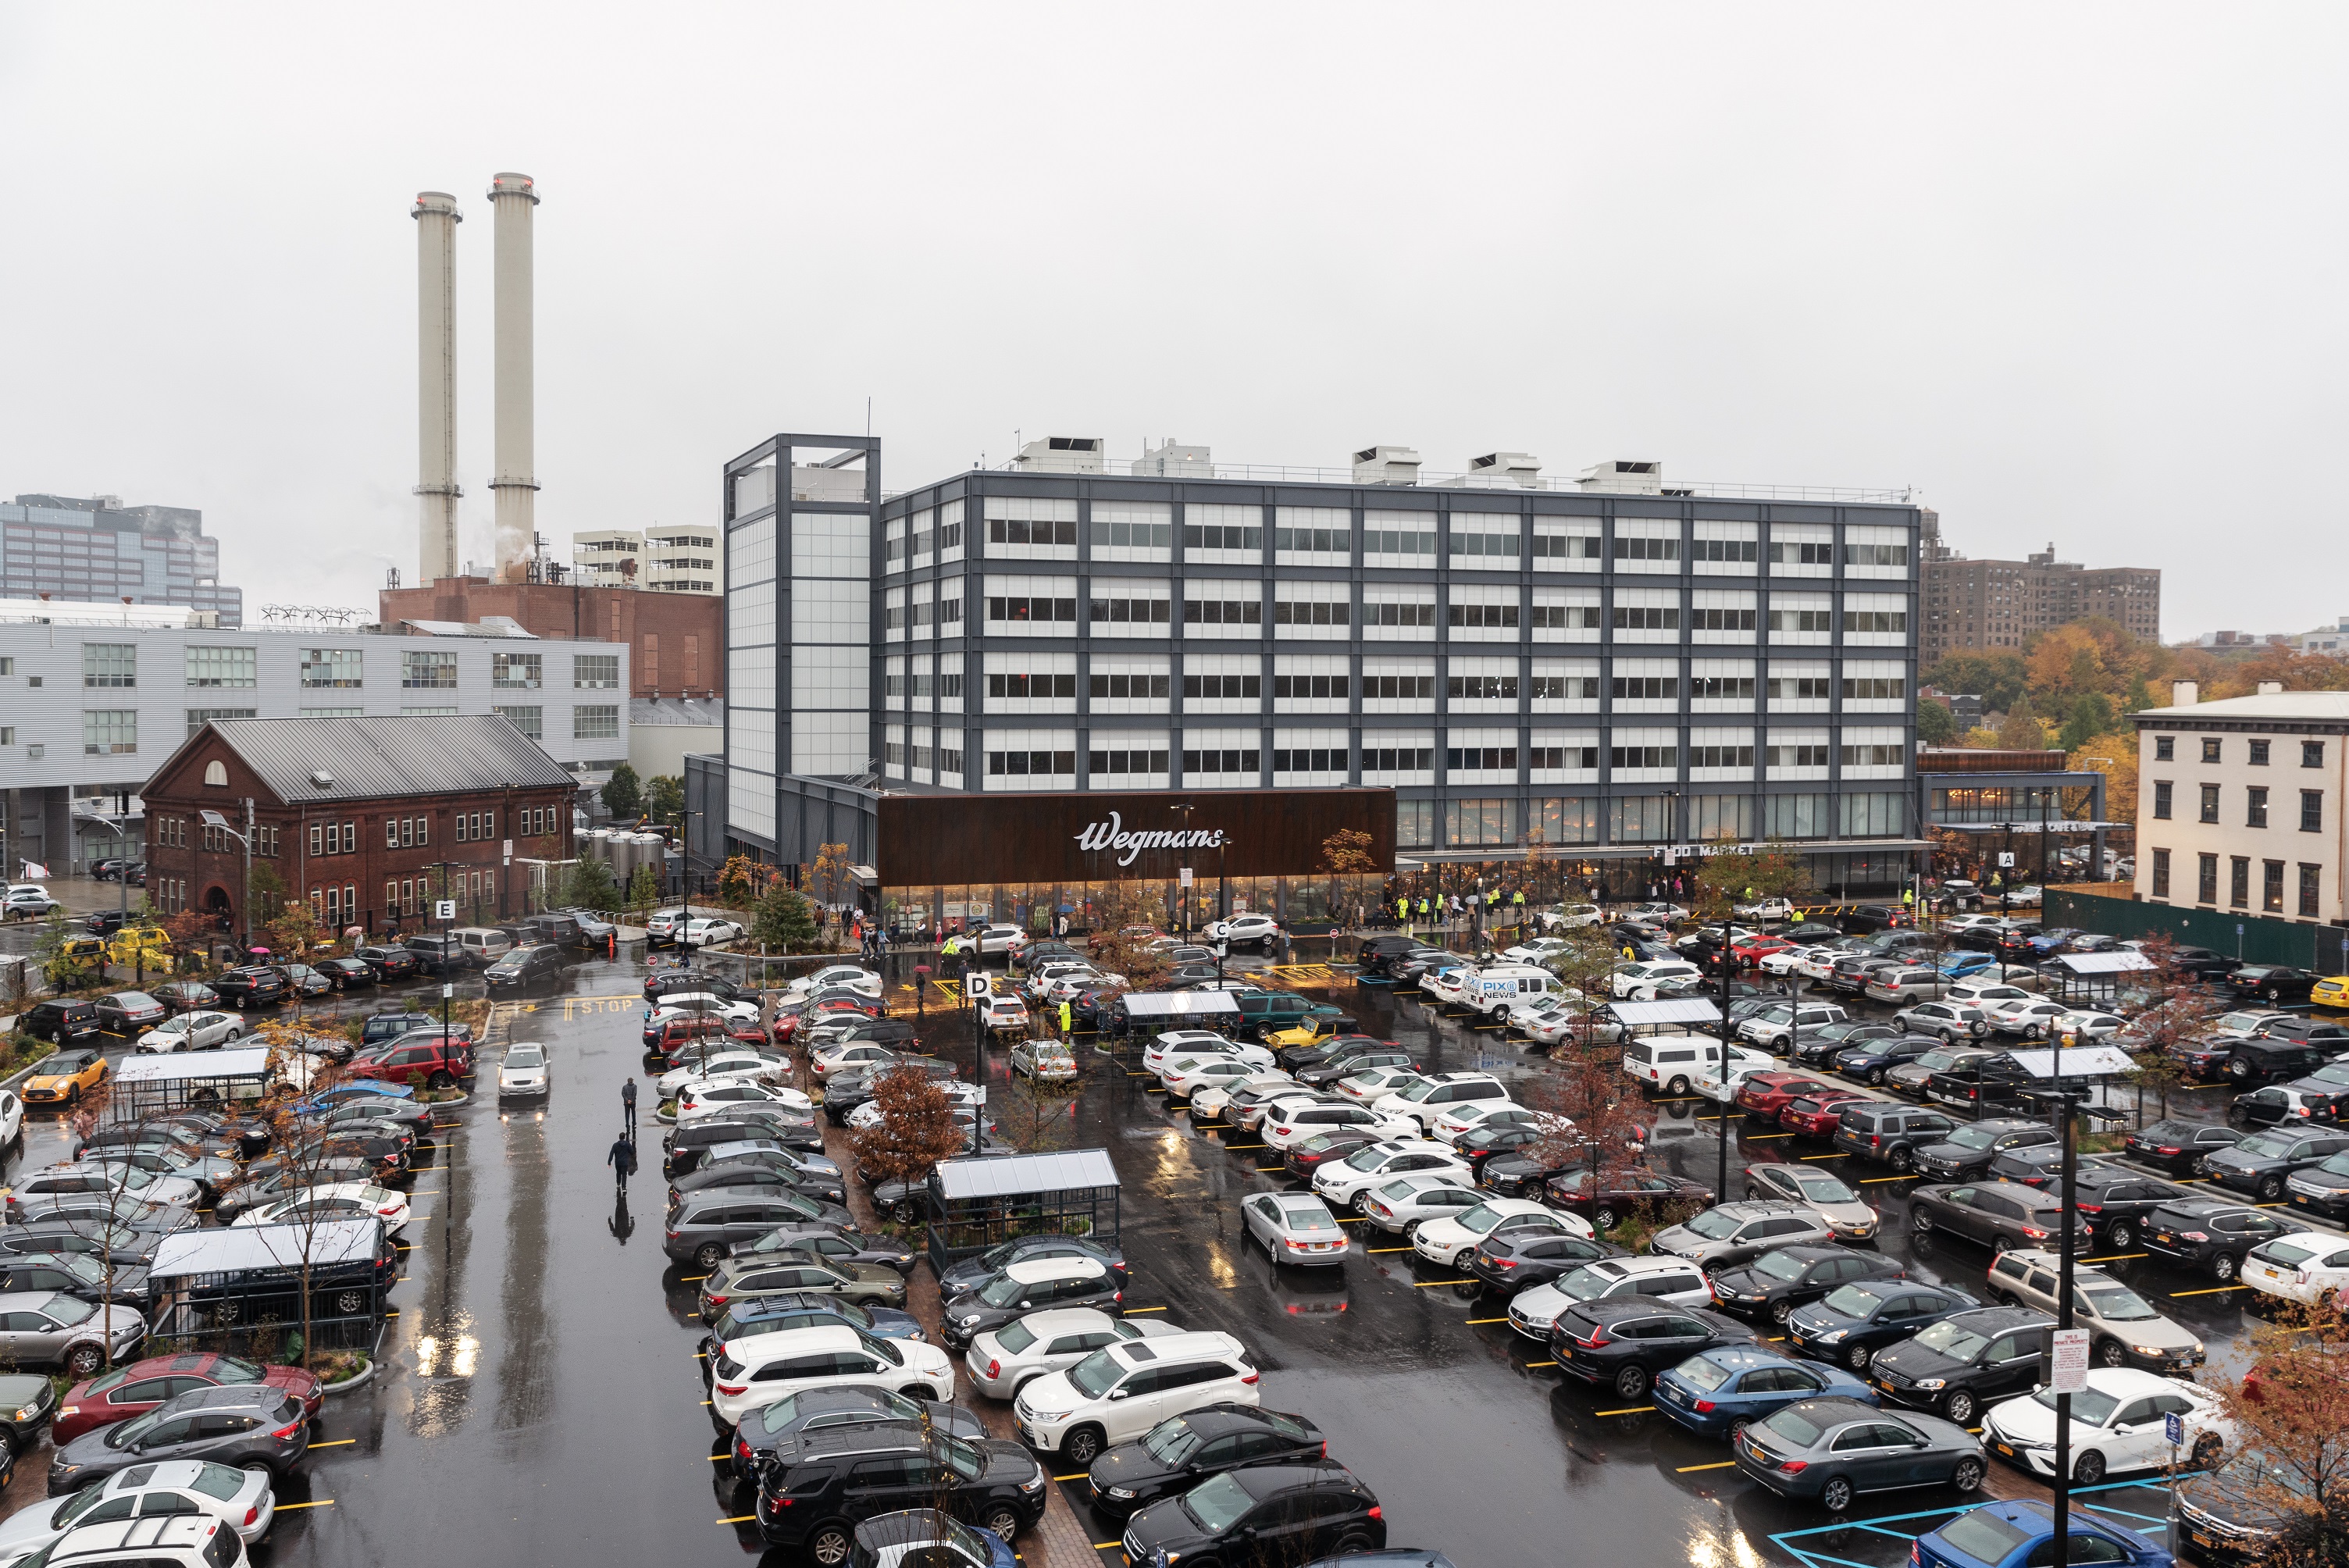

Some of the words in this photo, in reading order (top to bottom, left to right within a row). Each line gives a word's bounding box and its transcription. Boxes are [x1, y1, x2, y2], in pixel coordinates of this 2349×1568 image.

[1074, 811, 1224, 866] Wegmans
[1654, 846, 1691, 857] FOD
[1699, 845, 1753, 856] MARKET
[2005, 855, 2012, 864] A
[441, 904, 450, 916] E
[1217, 925, 1226, 935] C
[1285, 968, 1337, 978] STOP
[972, 978, 987, 994] D
[581, 1000, 632, 1014] STOP
